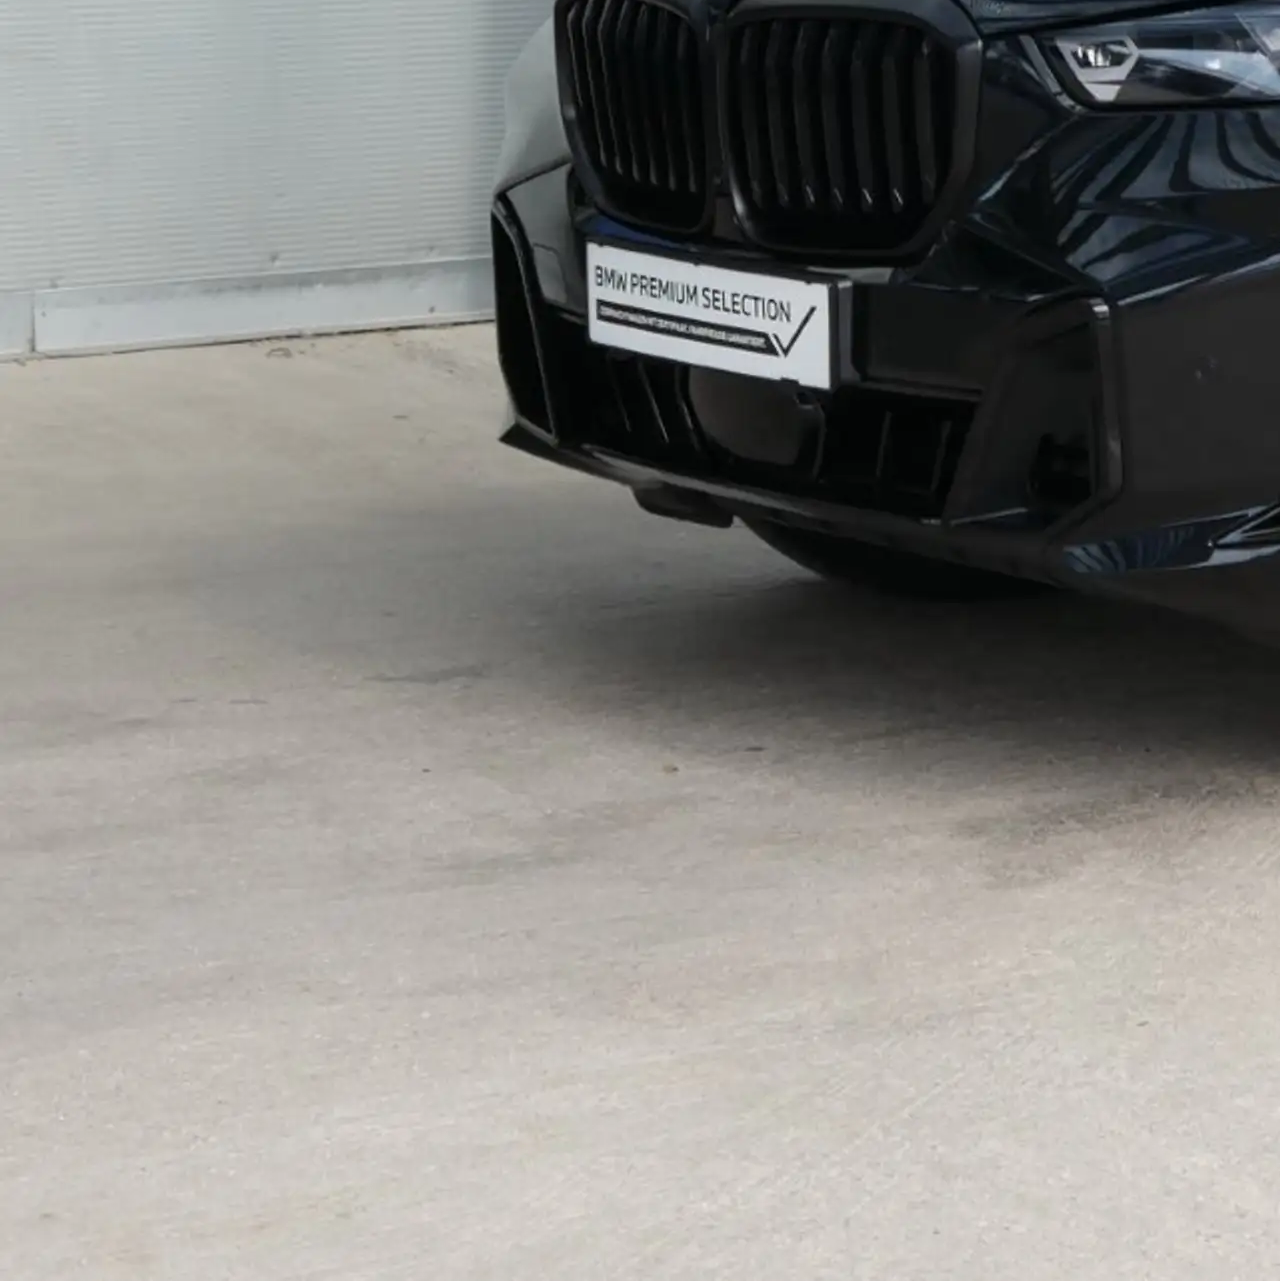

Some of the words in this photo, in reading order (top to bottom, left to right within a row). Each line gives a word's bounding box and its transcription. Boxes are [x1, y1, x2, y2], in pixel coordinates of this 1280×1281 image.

[594, 265, 628, 291] BMW
[630, 272, 698, 305] PREMIUM
[702, 286, 791, 322] SELECTION
